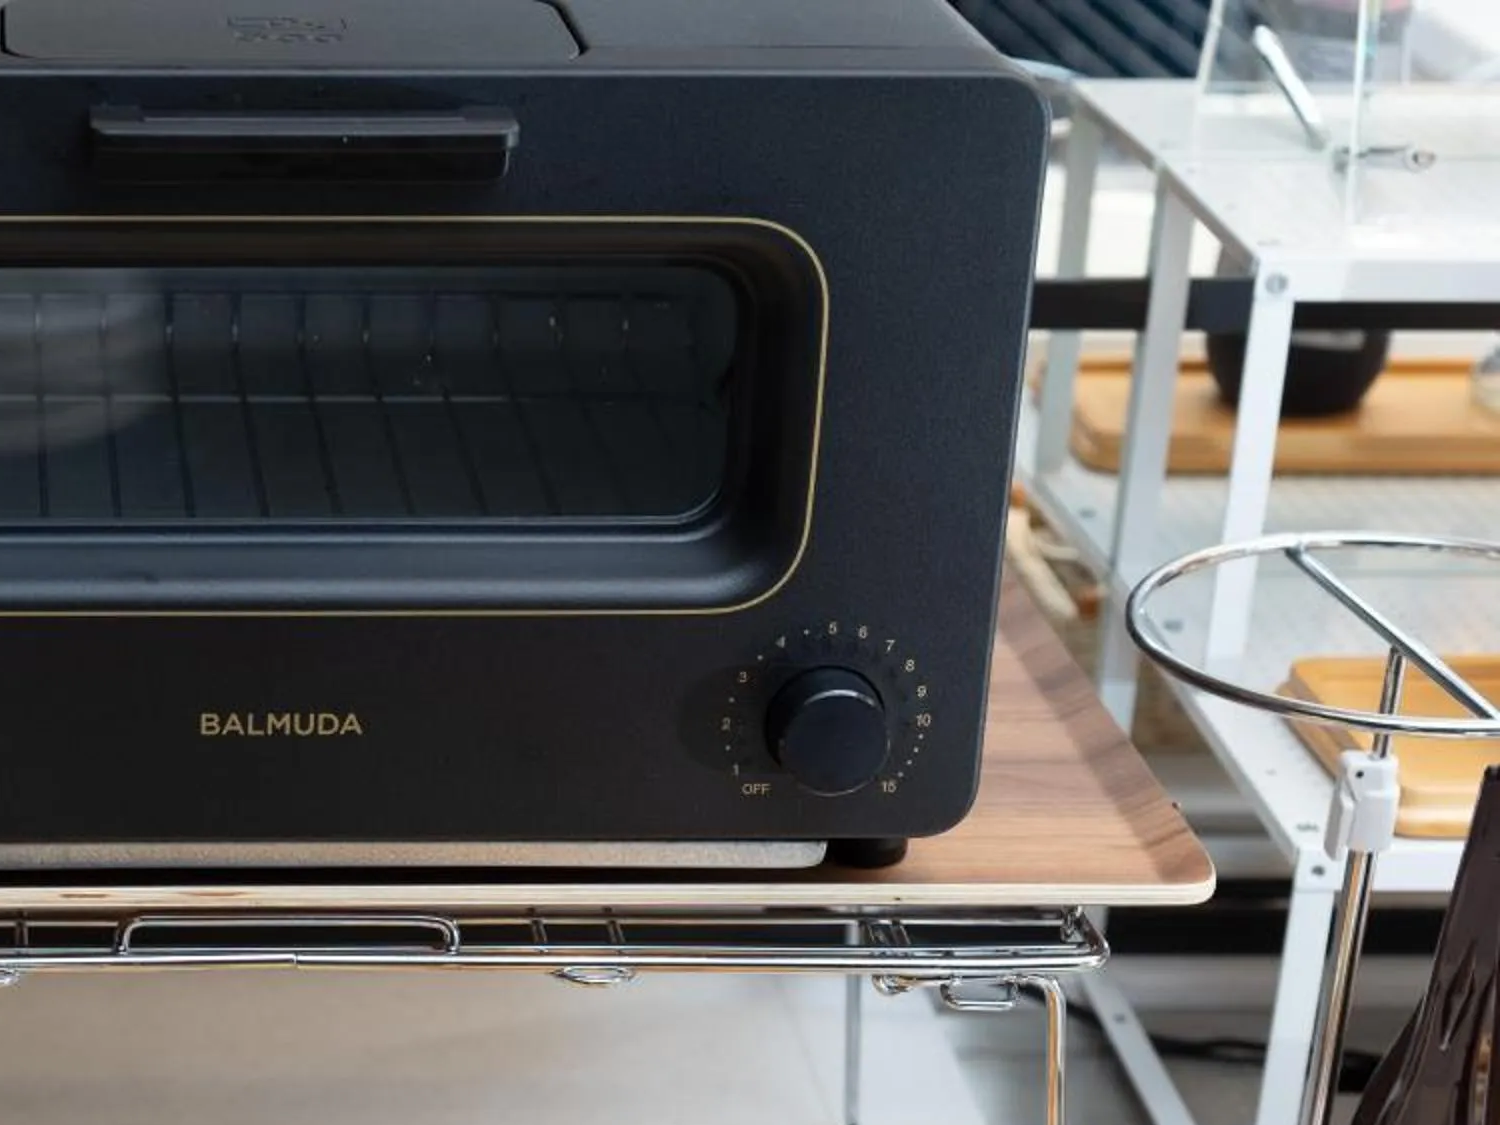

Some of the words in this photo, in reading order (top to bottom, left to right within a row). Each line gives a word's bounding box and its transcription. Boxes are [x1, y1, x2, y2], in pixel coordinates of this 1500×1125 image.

[828, 621, 838, 635] 5
[858, 625, 868, 639] 6
[775, 635, 786, 649] 4
[885, 639, 895, 652] 7
[904, 659, 915, 672] 8
[916, 685, 927, 698] 9
[200, 712, 363, 736] BALMUDA
[741, 783, 771, 796] OFF
